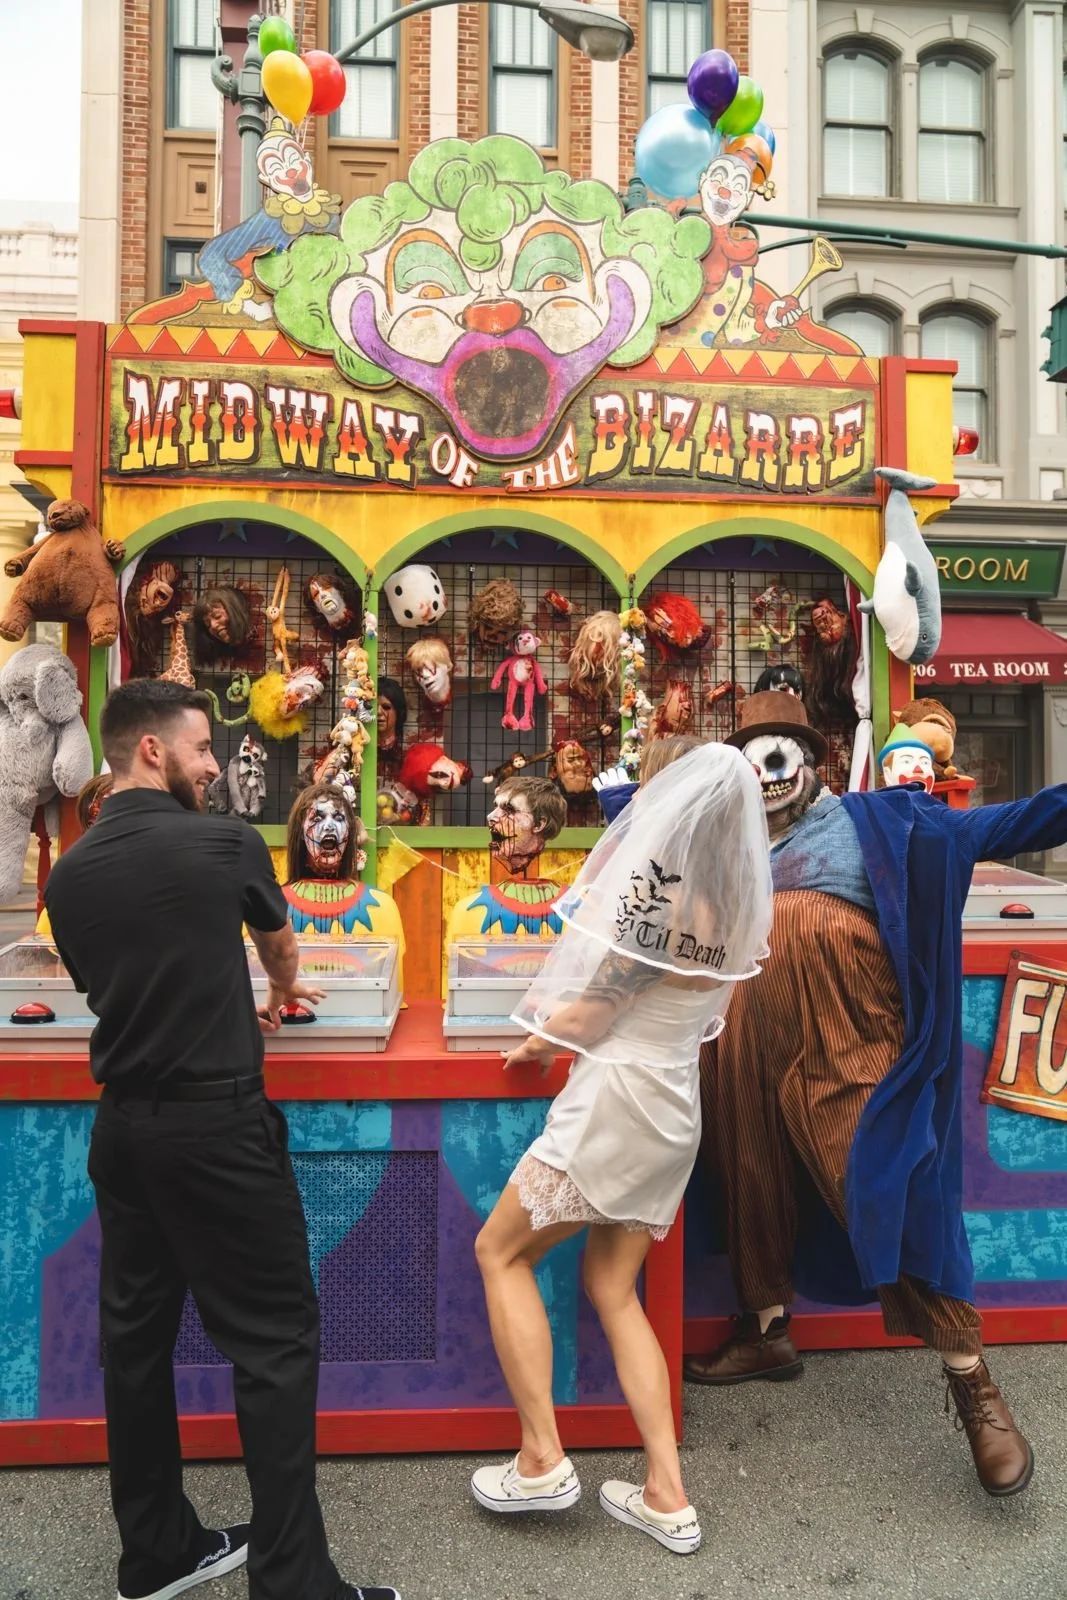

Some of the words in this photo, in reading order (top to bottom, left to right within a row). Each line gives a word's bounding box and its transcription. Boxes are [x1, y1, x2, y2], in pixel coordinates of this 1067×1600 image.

[119, 367, 426, 489] MIDWAY
[429, 431, 481, 489] OF
[503, 421, 582, 493] THE
[585, 388, 868, 493] BIZARRE
[935, 556, 1030, 581] ROOM
[950, 662, 989, 678] TEA
[993, 661, 1050, 677] ROOM
[674, 932, 727, 971] Death
